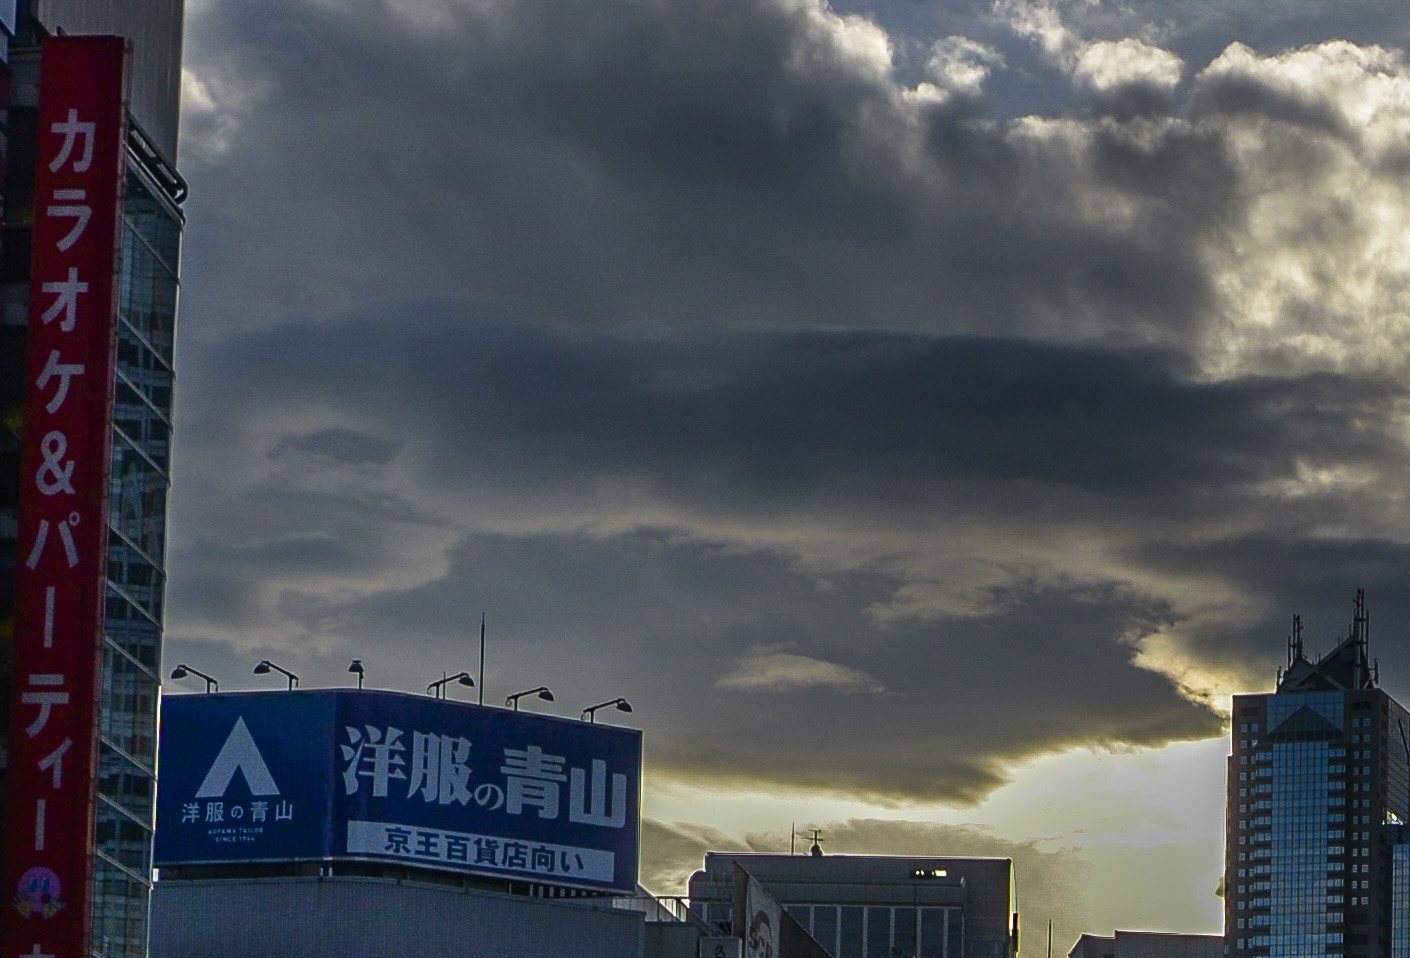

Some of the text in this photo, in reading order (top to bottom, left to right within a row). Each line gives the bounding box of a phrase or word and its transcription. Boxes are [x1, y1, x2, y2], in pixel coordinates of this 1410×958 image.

[20, 108, 96, 851] カラオケ&パーティー
[181, 800, 294, 824] 洋服の青山
[340, 724, 627, 829] 洋服の青山
[383, 826, 584, 873] 京王百貨店向い
